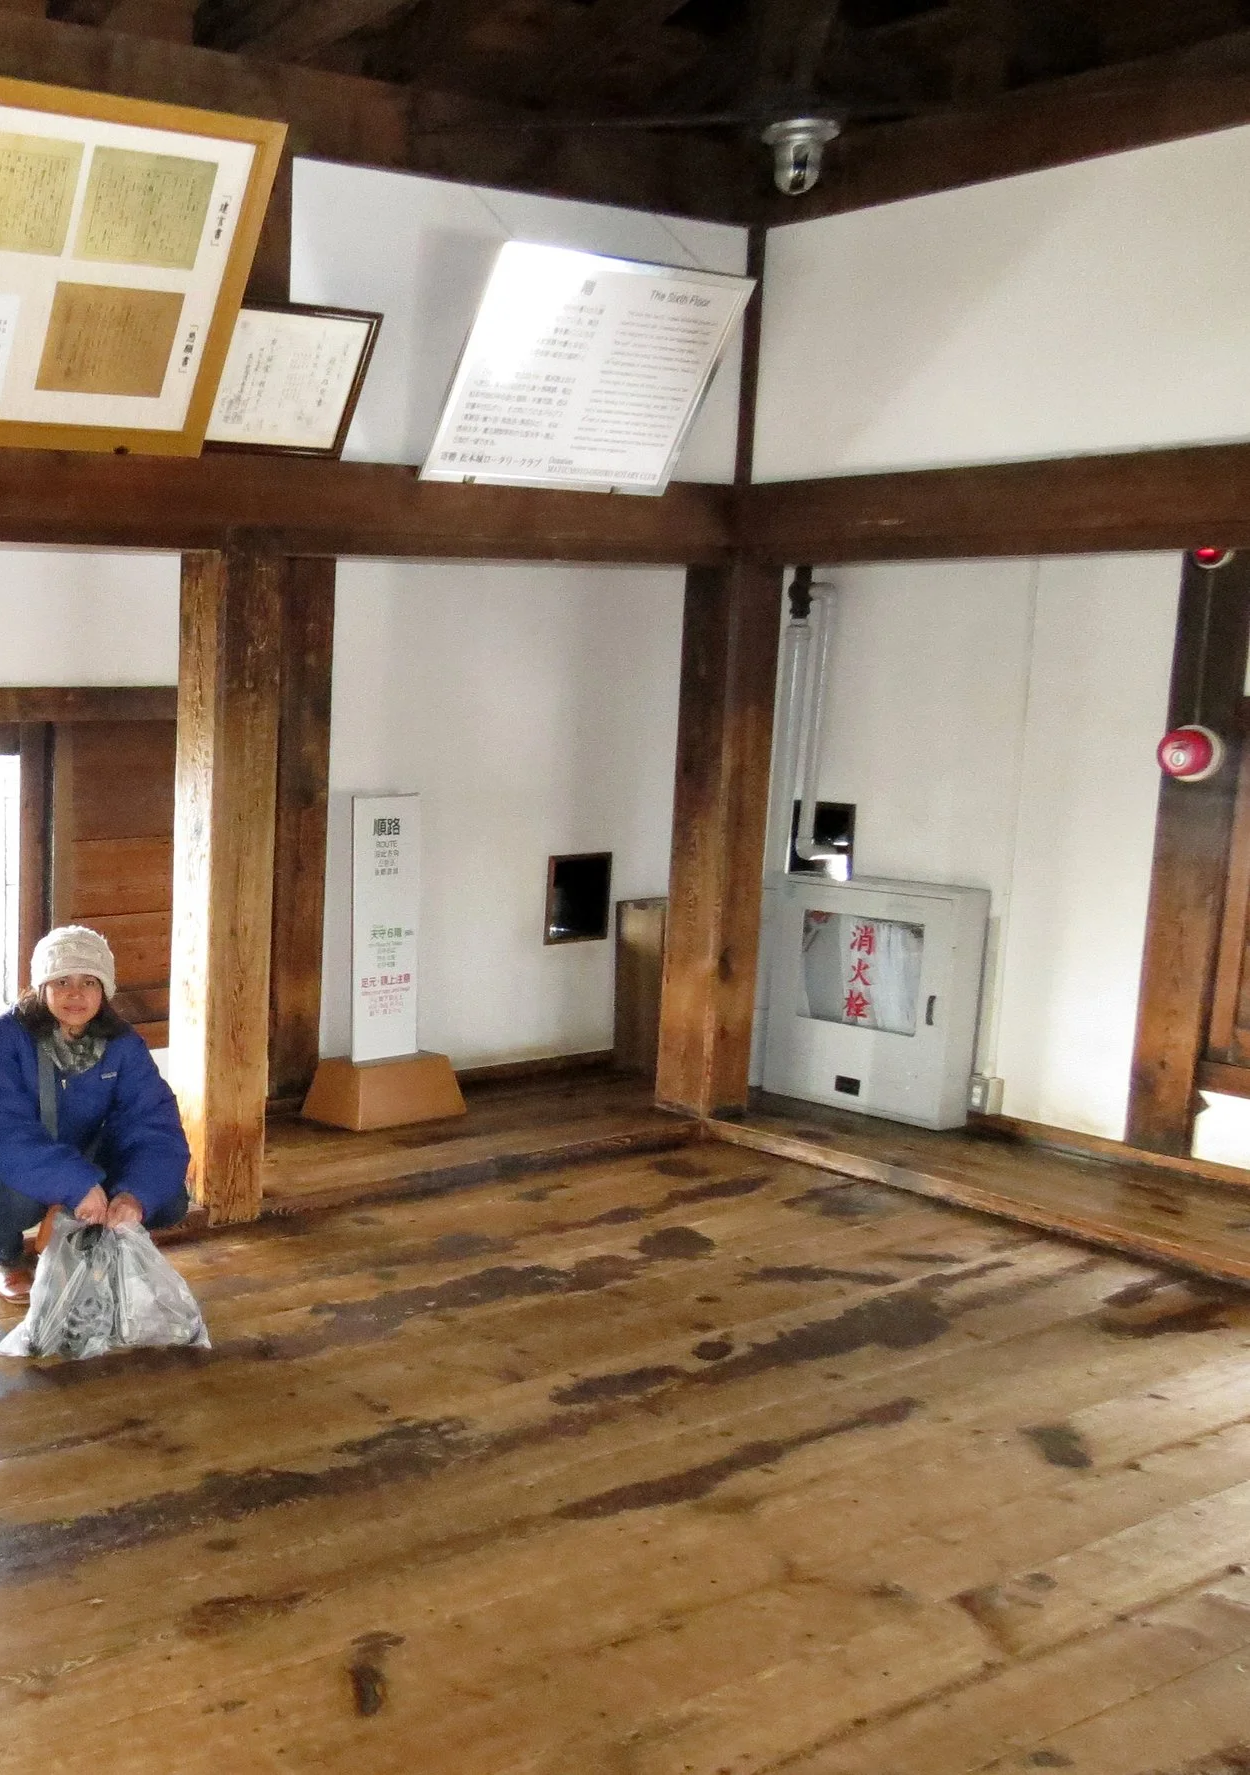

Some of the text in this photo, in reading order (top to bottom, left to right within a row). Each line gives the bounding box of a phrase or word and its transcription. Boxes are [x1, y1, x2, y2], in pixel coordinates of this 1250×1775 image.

[651, 289, 666, 302] The
[373, 817, 401, 836] 順路
[375, 839, 399, 849] ROUTE
[842, 924, 875, 1018] 消火栓
